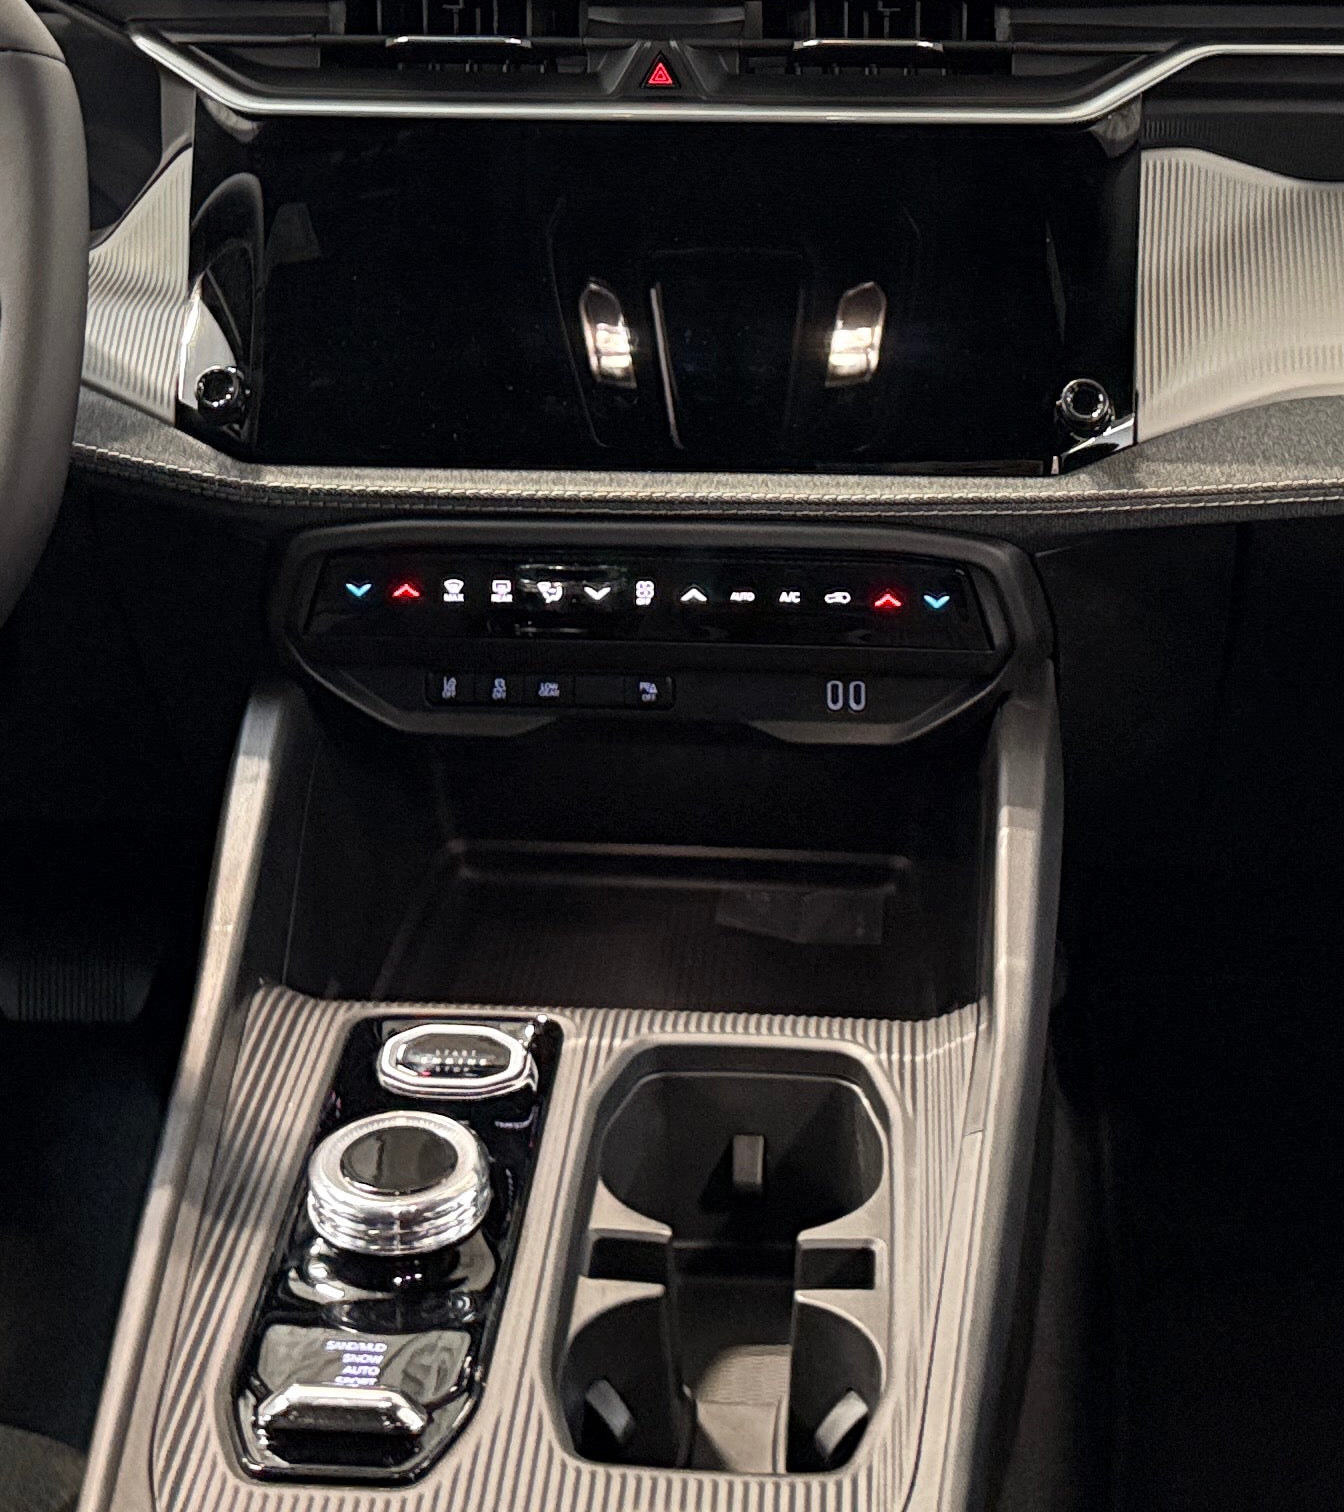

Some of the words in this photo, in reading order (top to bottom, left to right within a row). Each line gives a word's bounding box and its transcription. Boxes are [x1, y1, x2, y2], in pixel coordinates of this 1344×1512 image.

[730, 591, 755, 602] AUTO
[779, 591, 801, 603] A/C
[326, 1340, 388, 1352] SAND/MUD
[342, 1353, 384, 1364] SNOW
[341, 1365, 380, 1376] AUTO
